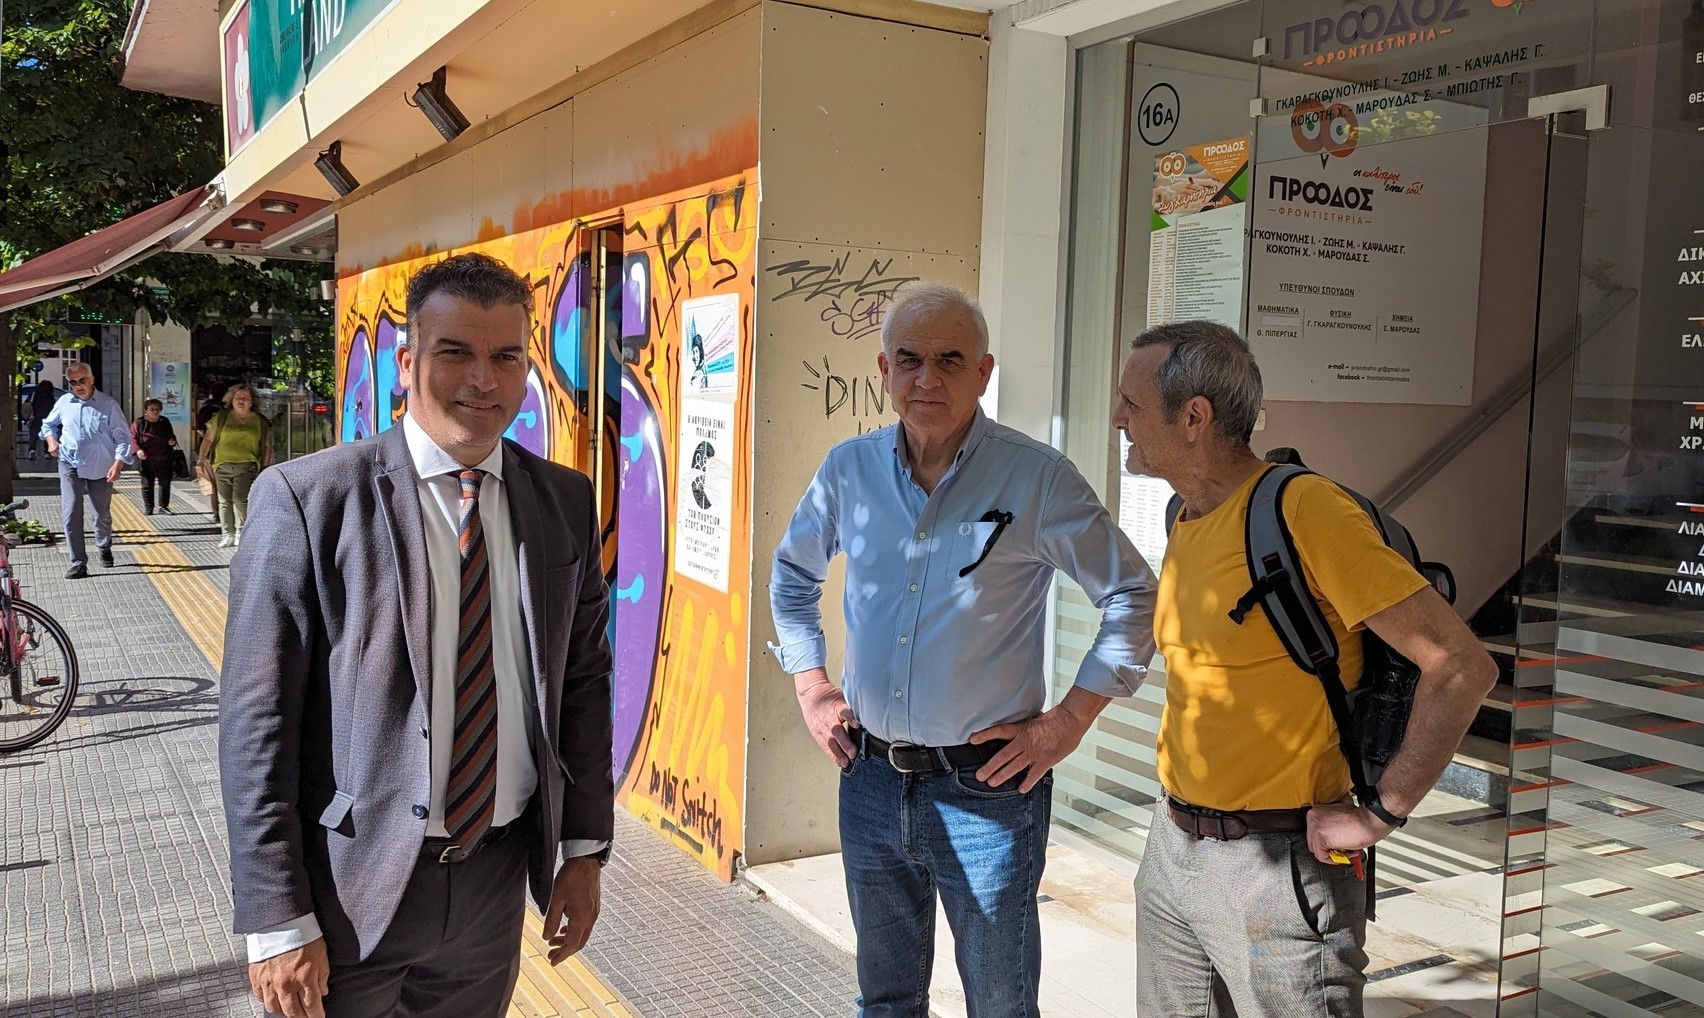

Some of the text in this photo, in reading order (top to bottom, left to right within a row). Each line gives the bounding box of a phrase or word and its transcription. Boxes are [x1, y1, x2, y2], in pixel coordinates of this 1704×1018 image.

[1316, 28, 1438, 66] ΦΡΟΝΤΙΣΤΗΡΙΑ
[1276, 79, 1380, 111] ΓΚΑΡΑΓΚΟΥΝΟΥΛΗΣ
[1401, 66, 1433, 85] ΖΩΗΣ
[1465, 47, 1528, 72] ΚΑΨΑΛΗΣ
[1291, 107, 1333, 127] ΚΟΚΟΤΗ
[1356, 93, 1417, 114] ΜΑΡΟΥΔΑΣ
[1447, 74, 1503, 96] ΜΠΙΩΤΗΣ
[1203, 140, 1245, 157] ΠΡΟΟΔΟΣ
[1269, 175, 1374, 212] ΠΡΟΟΔΟΣ
[1278, 207, 1363, 225] ΦΡΟΝΤΙΣΤΗΡΙΑ
[1266, 244, 1301, 257] ΚΟΚΟΤΗ
[1318, 249, 1362, 262] ΜΑΡΟΥΔΑΣ
[1323, 237, 1345, 248] ΖΩΗΣ
[1362, 241, 1399, 254] ΚΑΨΑΛΗΣ
[1279, 283, 1355, 297] ΥΠΕΥΘΥΝΟΙ ΣΠΟΥΔΩΝ
[1257, 304, 1299, 314] ΜΑΘΗΜΑΤΙΚΑ
[1329, 310, 1352, 318] ΦΥΣΙΚΗ
[1392, 314, 1413, 322] ΧΗΜΕΙΑ
[1265, 330, 1298, 338] ΠΙΠΕΡΓΙΑΣ
[1390, 326, 1420, 334] ΜΑΡΟΥΔΑΣ
